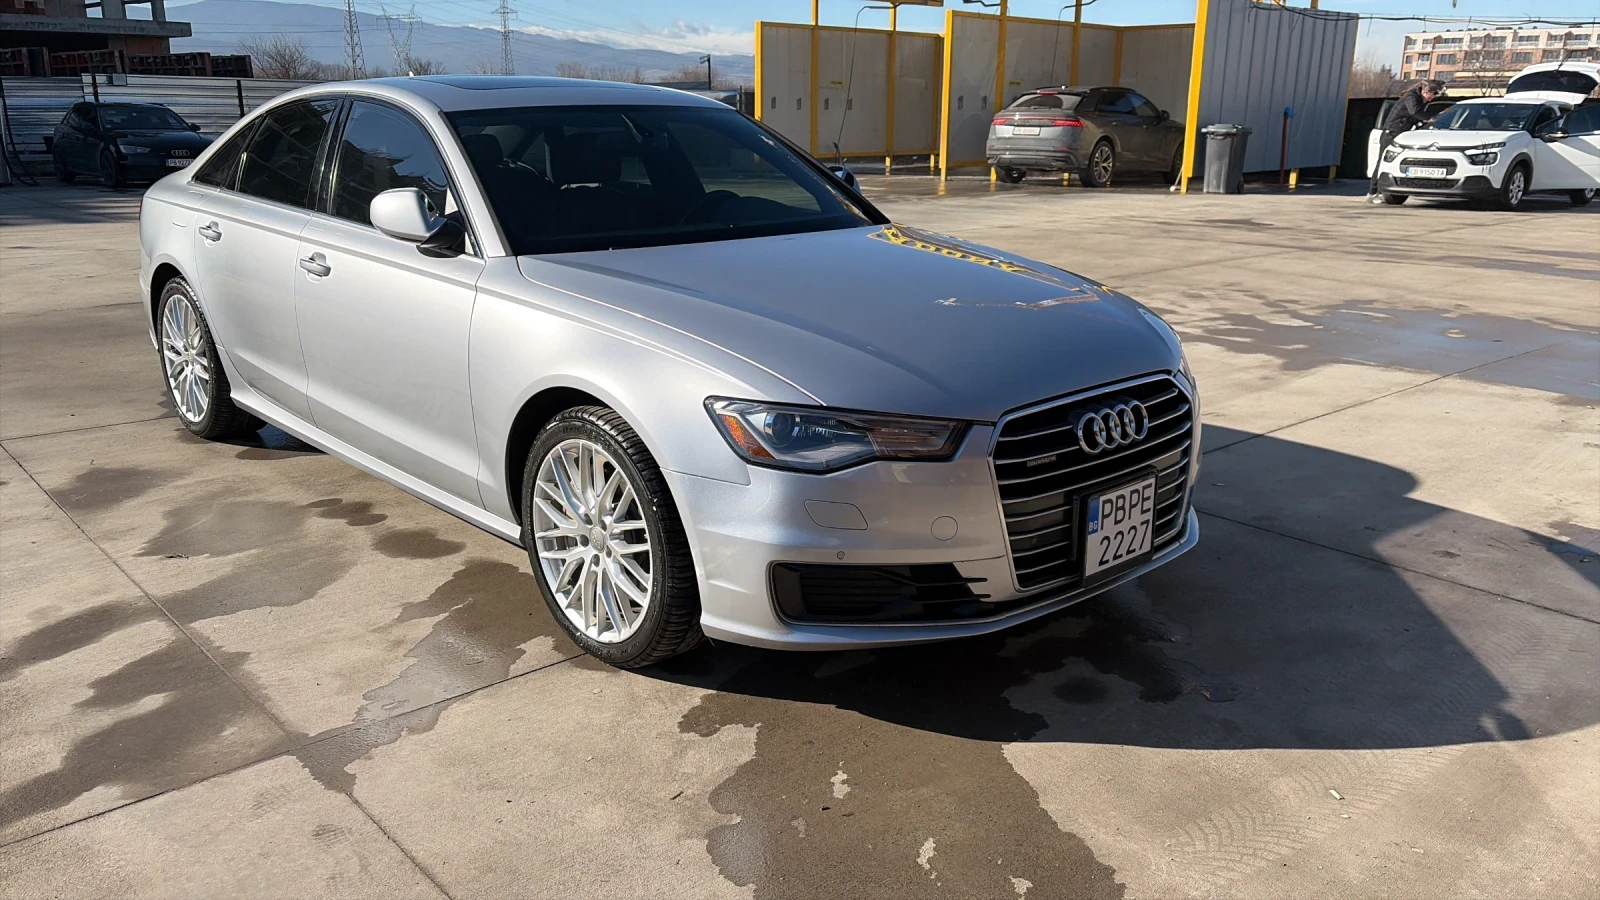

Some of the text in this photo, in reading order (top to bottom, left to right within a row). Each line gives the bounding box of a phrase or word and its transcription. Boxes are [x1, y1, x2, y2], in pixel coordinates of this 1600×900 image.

[1088, 520, 1098, 532] BG
[1100, 483, 1153, 531] PBPE
[1098, 518, 1151, 567] 2227
